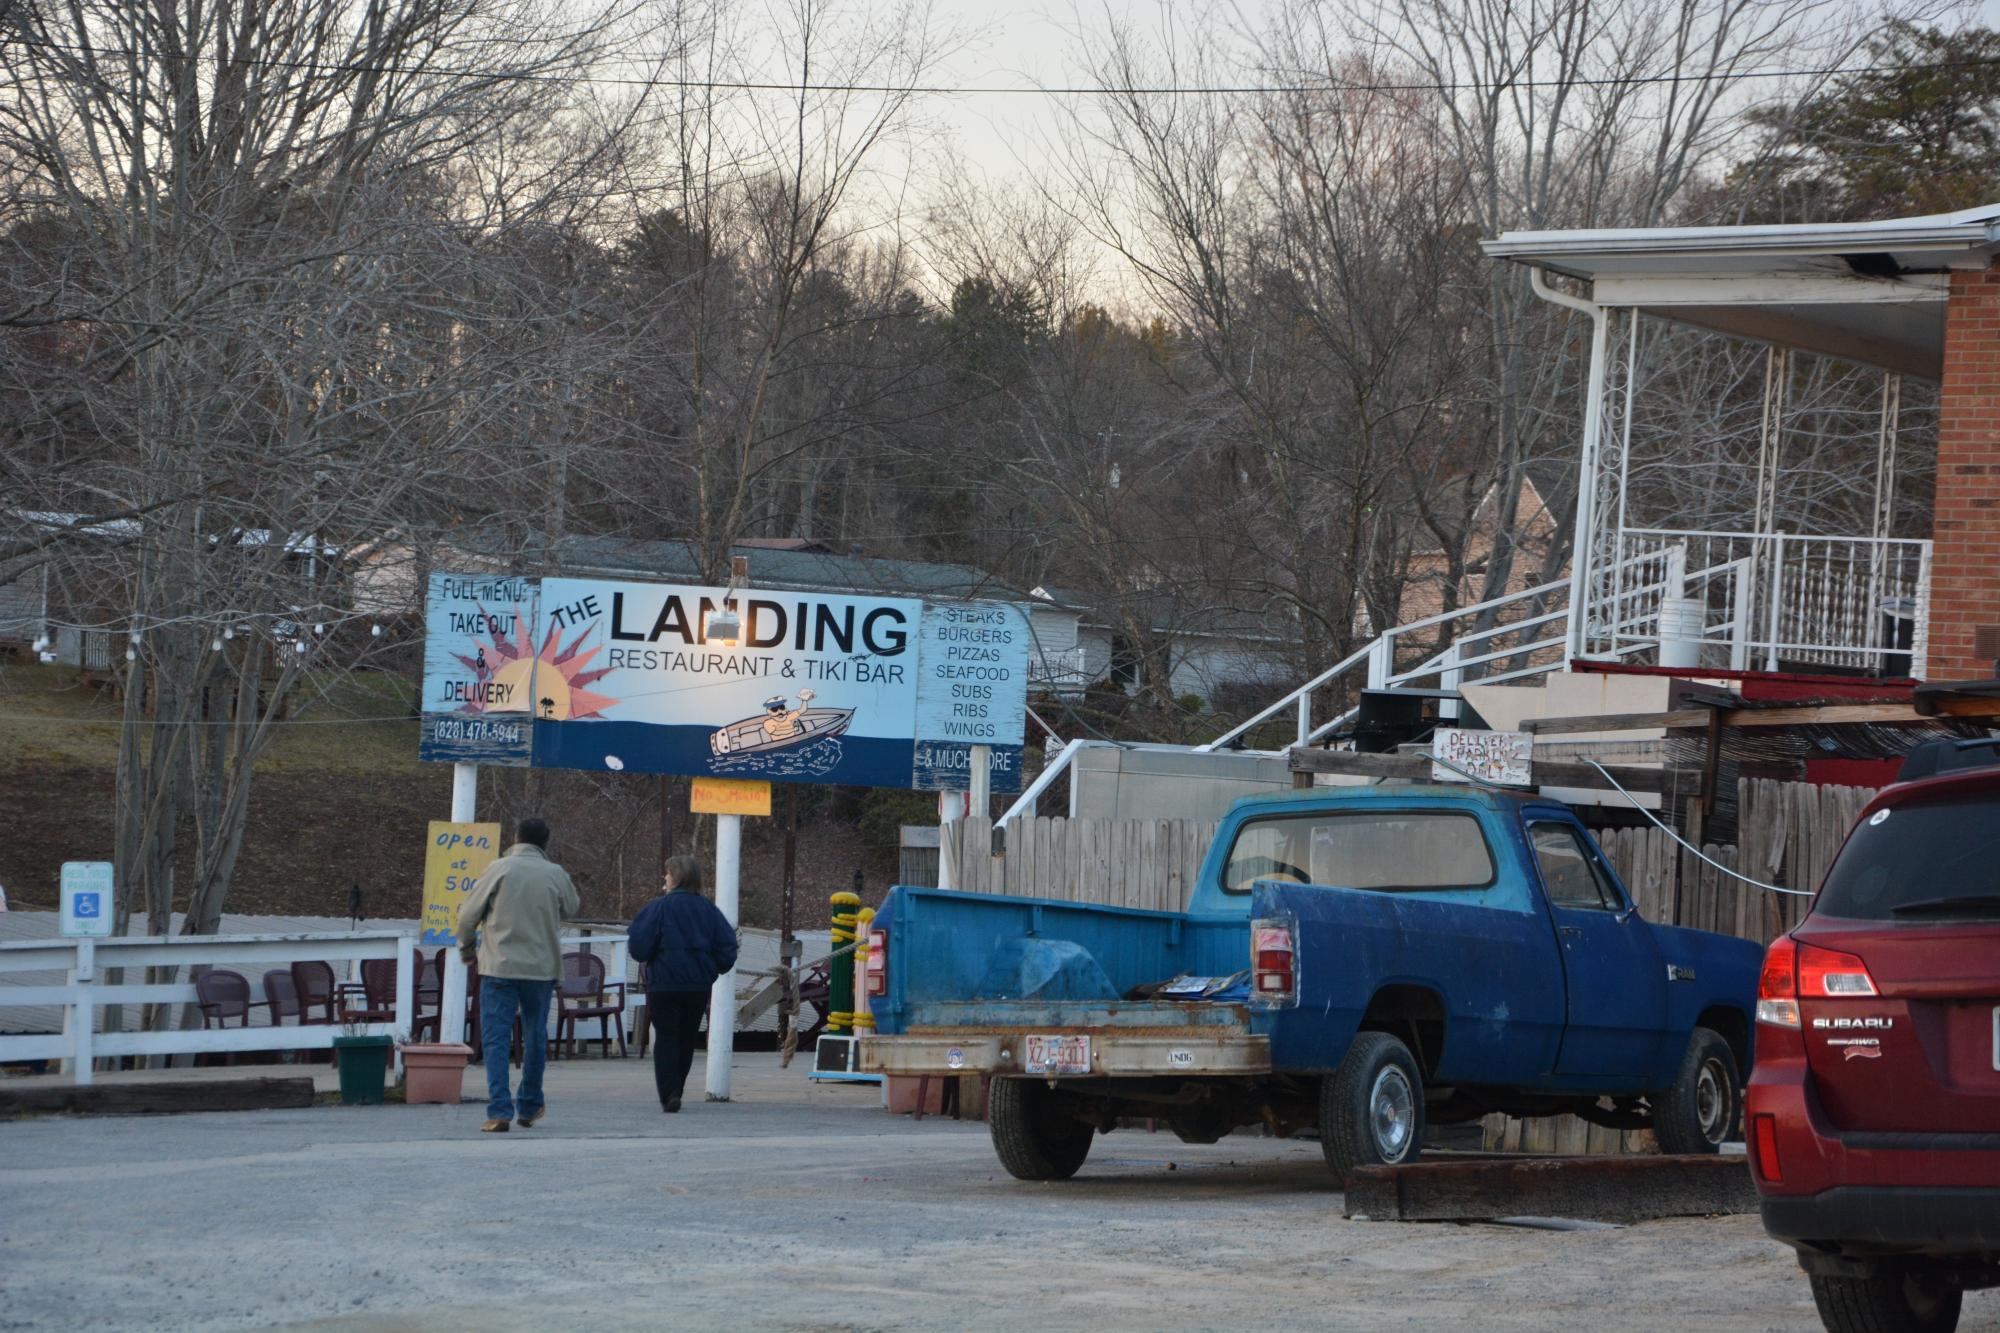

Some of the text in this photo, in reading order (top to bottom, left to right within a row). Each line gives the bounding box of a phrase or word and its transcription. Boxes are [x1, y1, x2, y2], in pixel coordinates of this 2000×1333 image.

[443, 578, 477, 600] FULL
[551, 595, 602, 629] THE
[947, 608, 1006, 625] STEAKS
[449, 612, 517, 635] TAKE OUT
[938, 627, 1012, 645] BURGERS
[476, 647, 486, 669] &
[948, 646, 1000, 662] PIZZAS
[609, 648, 904, 685] RESTAURANT & TIKI BAR
[936, 664, 1010, 681] SEAFOOD
[444, 680, 514, 704] DELIVERY
[951, 683, 992, 699] SUBS
[953, 703, 988, 718] RIBS
[434, 720, 463, 742] (828)
[944, 721, 995, 738] WINGS
[1450, 732, 1514, 747] DELIVER
[925, 748, 932, 768] &
[436, 832, 489, 850] open
[451, 858, 468, 870] at
[1813, 1018, 1893, 1029] SUBARU
[1847, 1038, 1880, 1046] AWD
